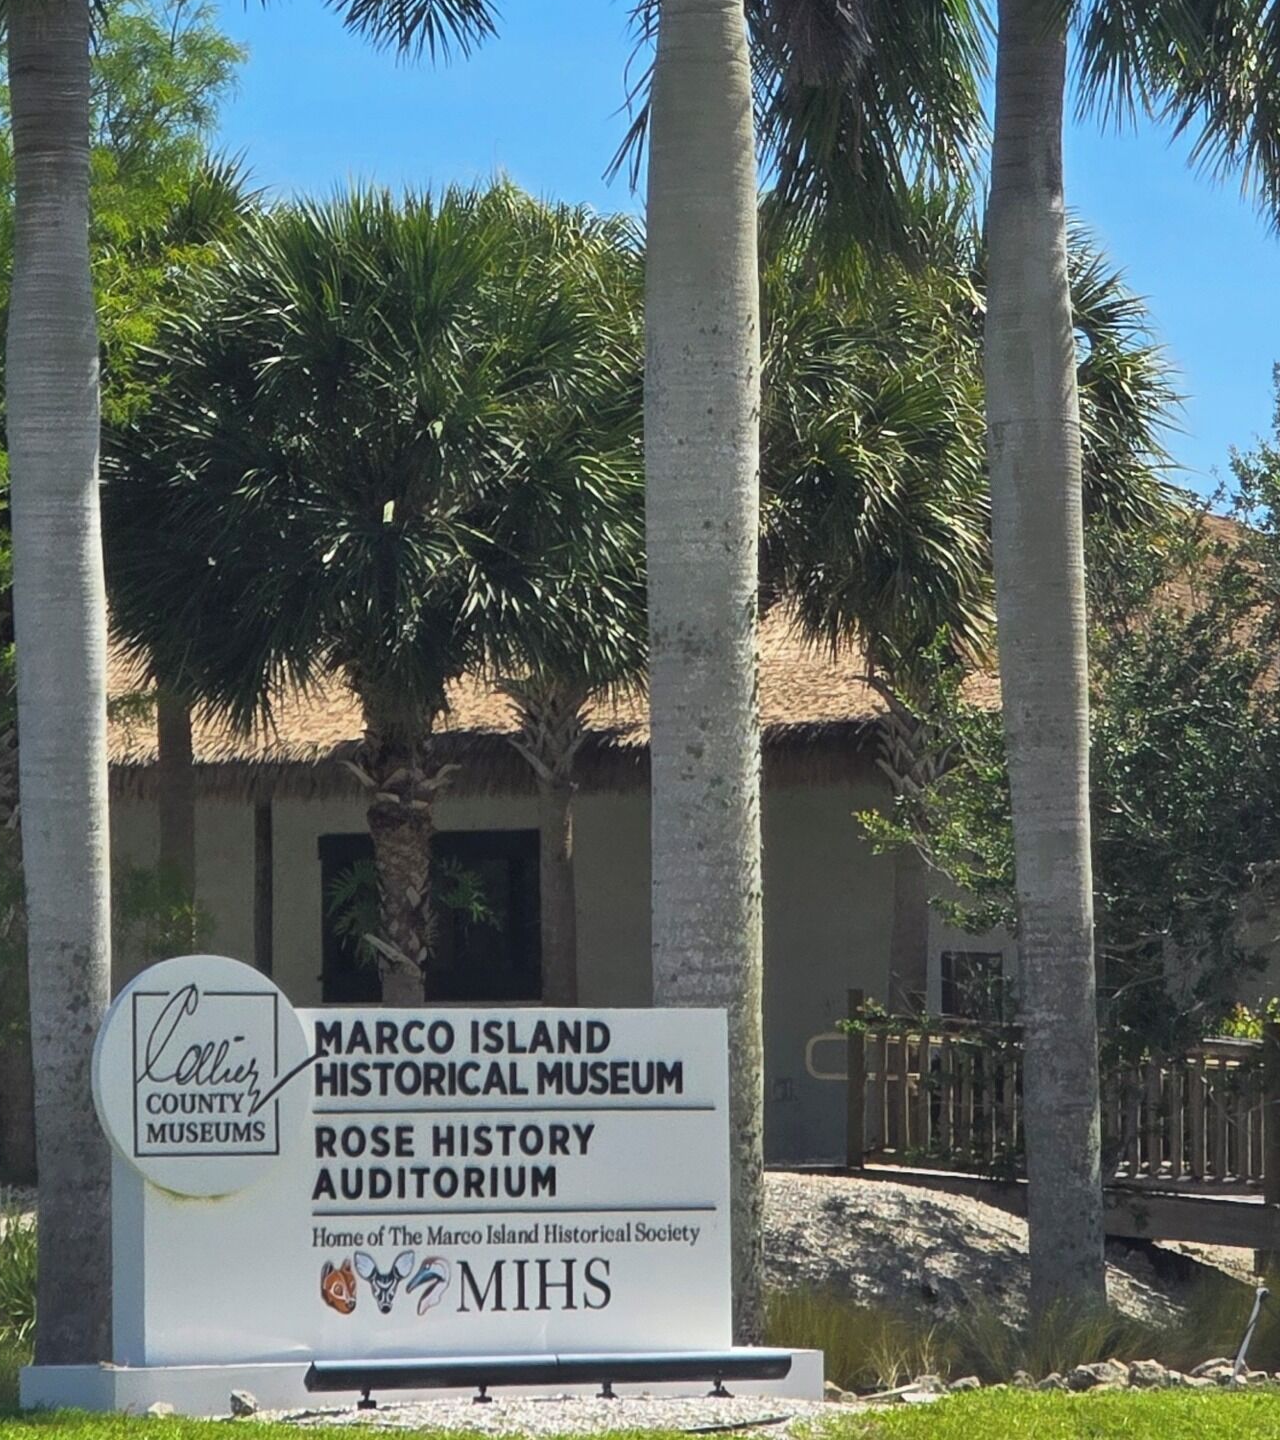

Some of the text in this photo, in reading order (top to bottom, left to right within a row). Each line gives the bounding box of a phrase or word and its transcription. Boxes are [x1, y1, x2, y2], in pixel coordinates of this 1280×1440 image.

[135, 983, 264, 1111] Collier
[315, 1019, 610, 1055] MARCO ISLAND
[314, 1060, 683, 1098] HISTORICAL MUSEUM
[146, 1092, 242, 1115] COUNTY
[146, 1119, 265, 1144] MUSEUMS
[315, 1122, 595, 1158] ROSE HISTORY
[312, 1166, 557, 1201] AUDITORIUM
[312, 1222, 700, 1248] Home of The Marco Island Historical Society
[457, 1258, 612, 1313] MIHS
